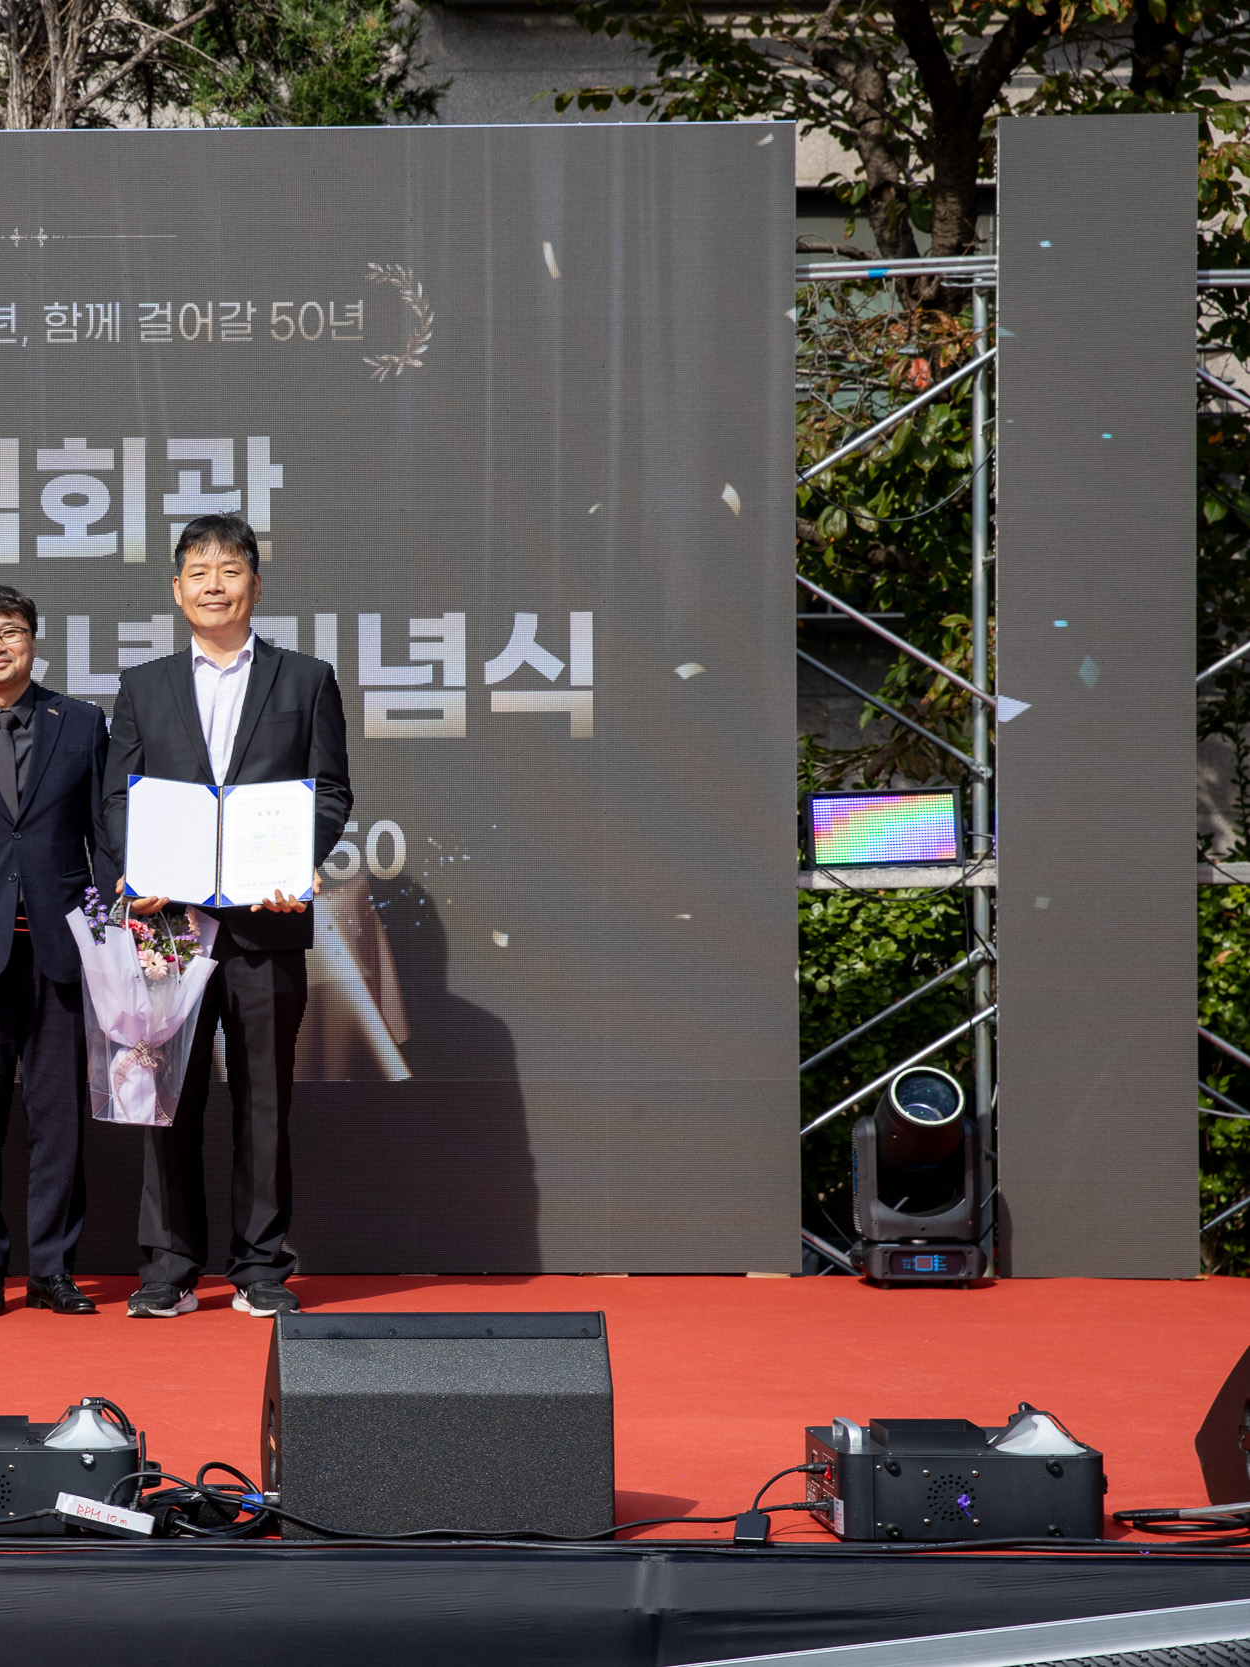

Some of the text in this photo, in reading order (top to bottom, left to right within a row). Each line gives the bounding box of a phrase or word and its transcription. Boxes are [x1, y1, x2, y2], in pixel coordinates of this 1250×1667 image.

[43, 301, 120, 343] 함께
[138, 300, 257, 342] 걸어갈
[270, 299, 364, 342] 50년
[106, 1513, 118, 1524] 10
